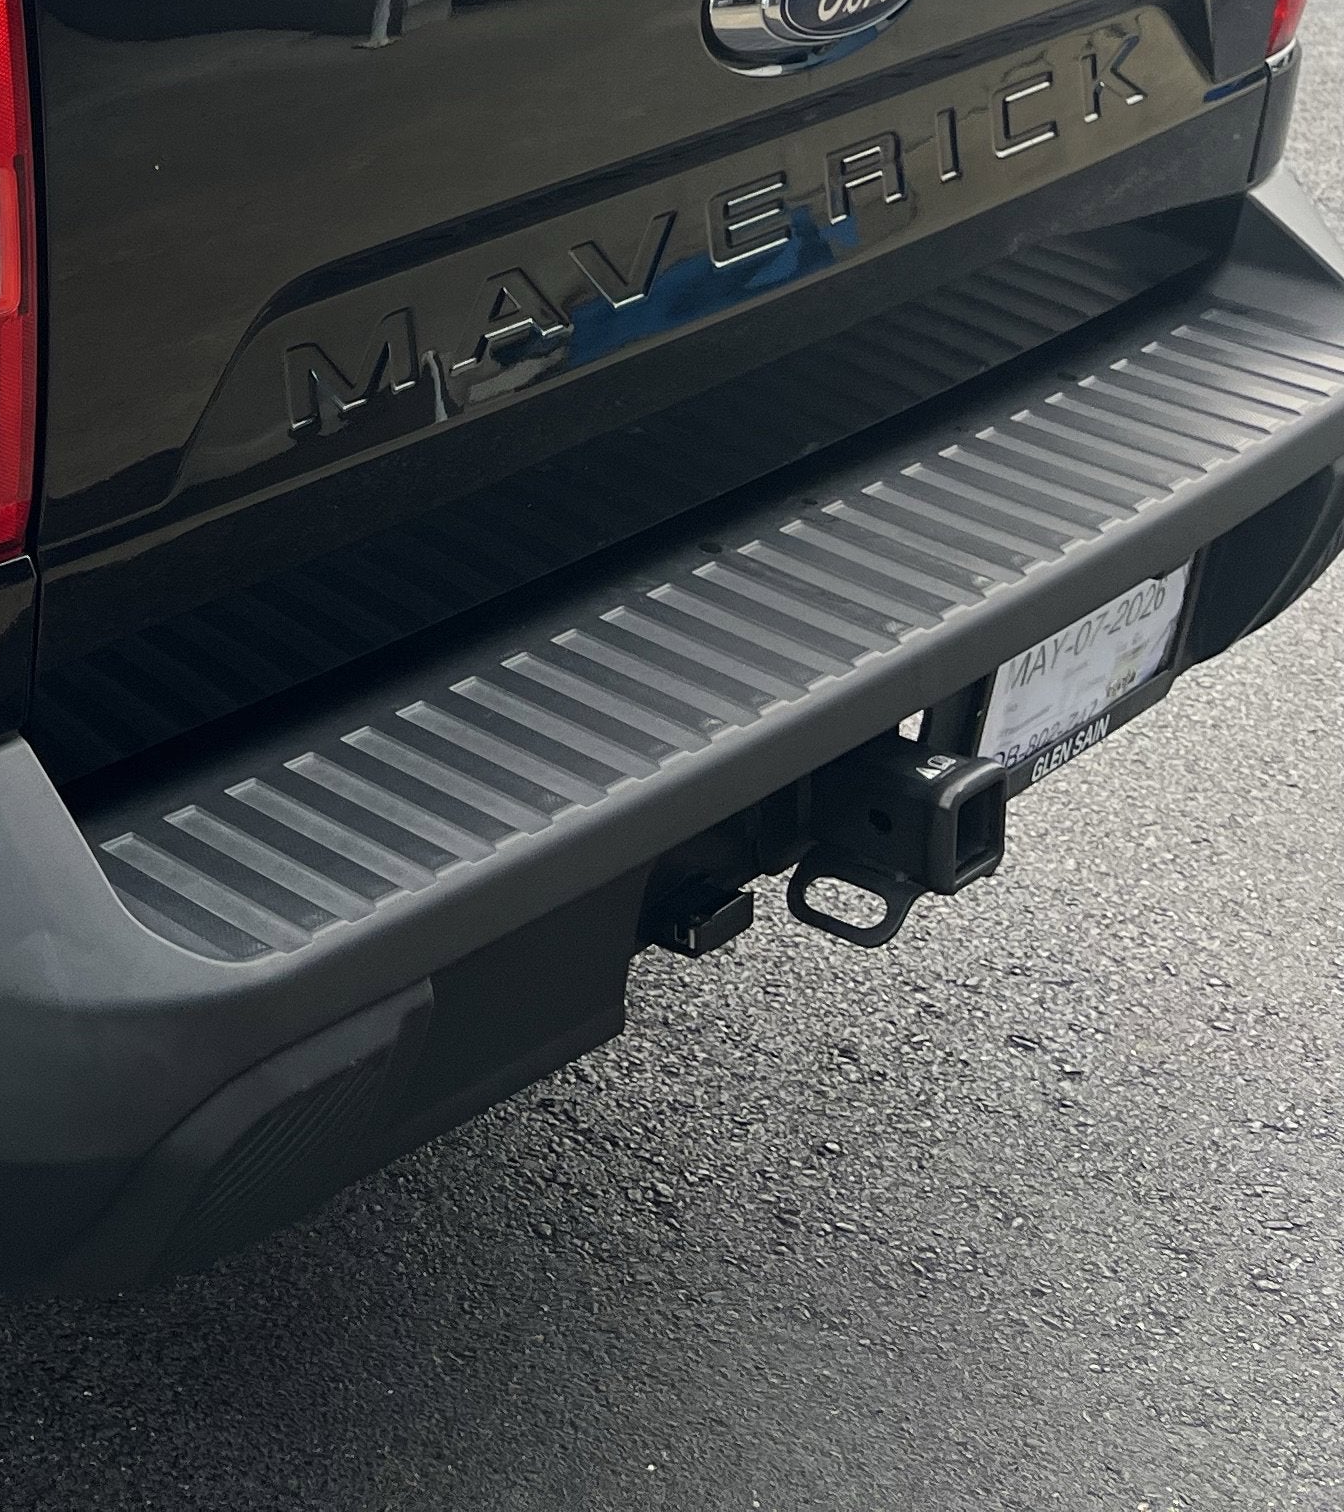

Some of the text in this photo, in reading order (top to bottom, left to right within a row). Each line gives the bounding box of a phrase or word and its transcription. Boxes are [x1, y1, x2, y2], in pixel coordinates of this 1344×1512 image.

[284, 32, 1146, 434] MAVERICK
[1030, 713, 1111, 783] GLEN SAIN
